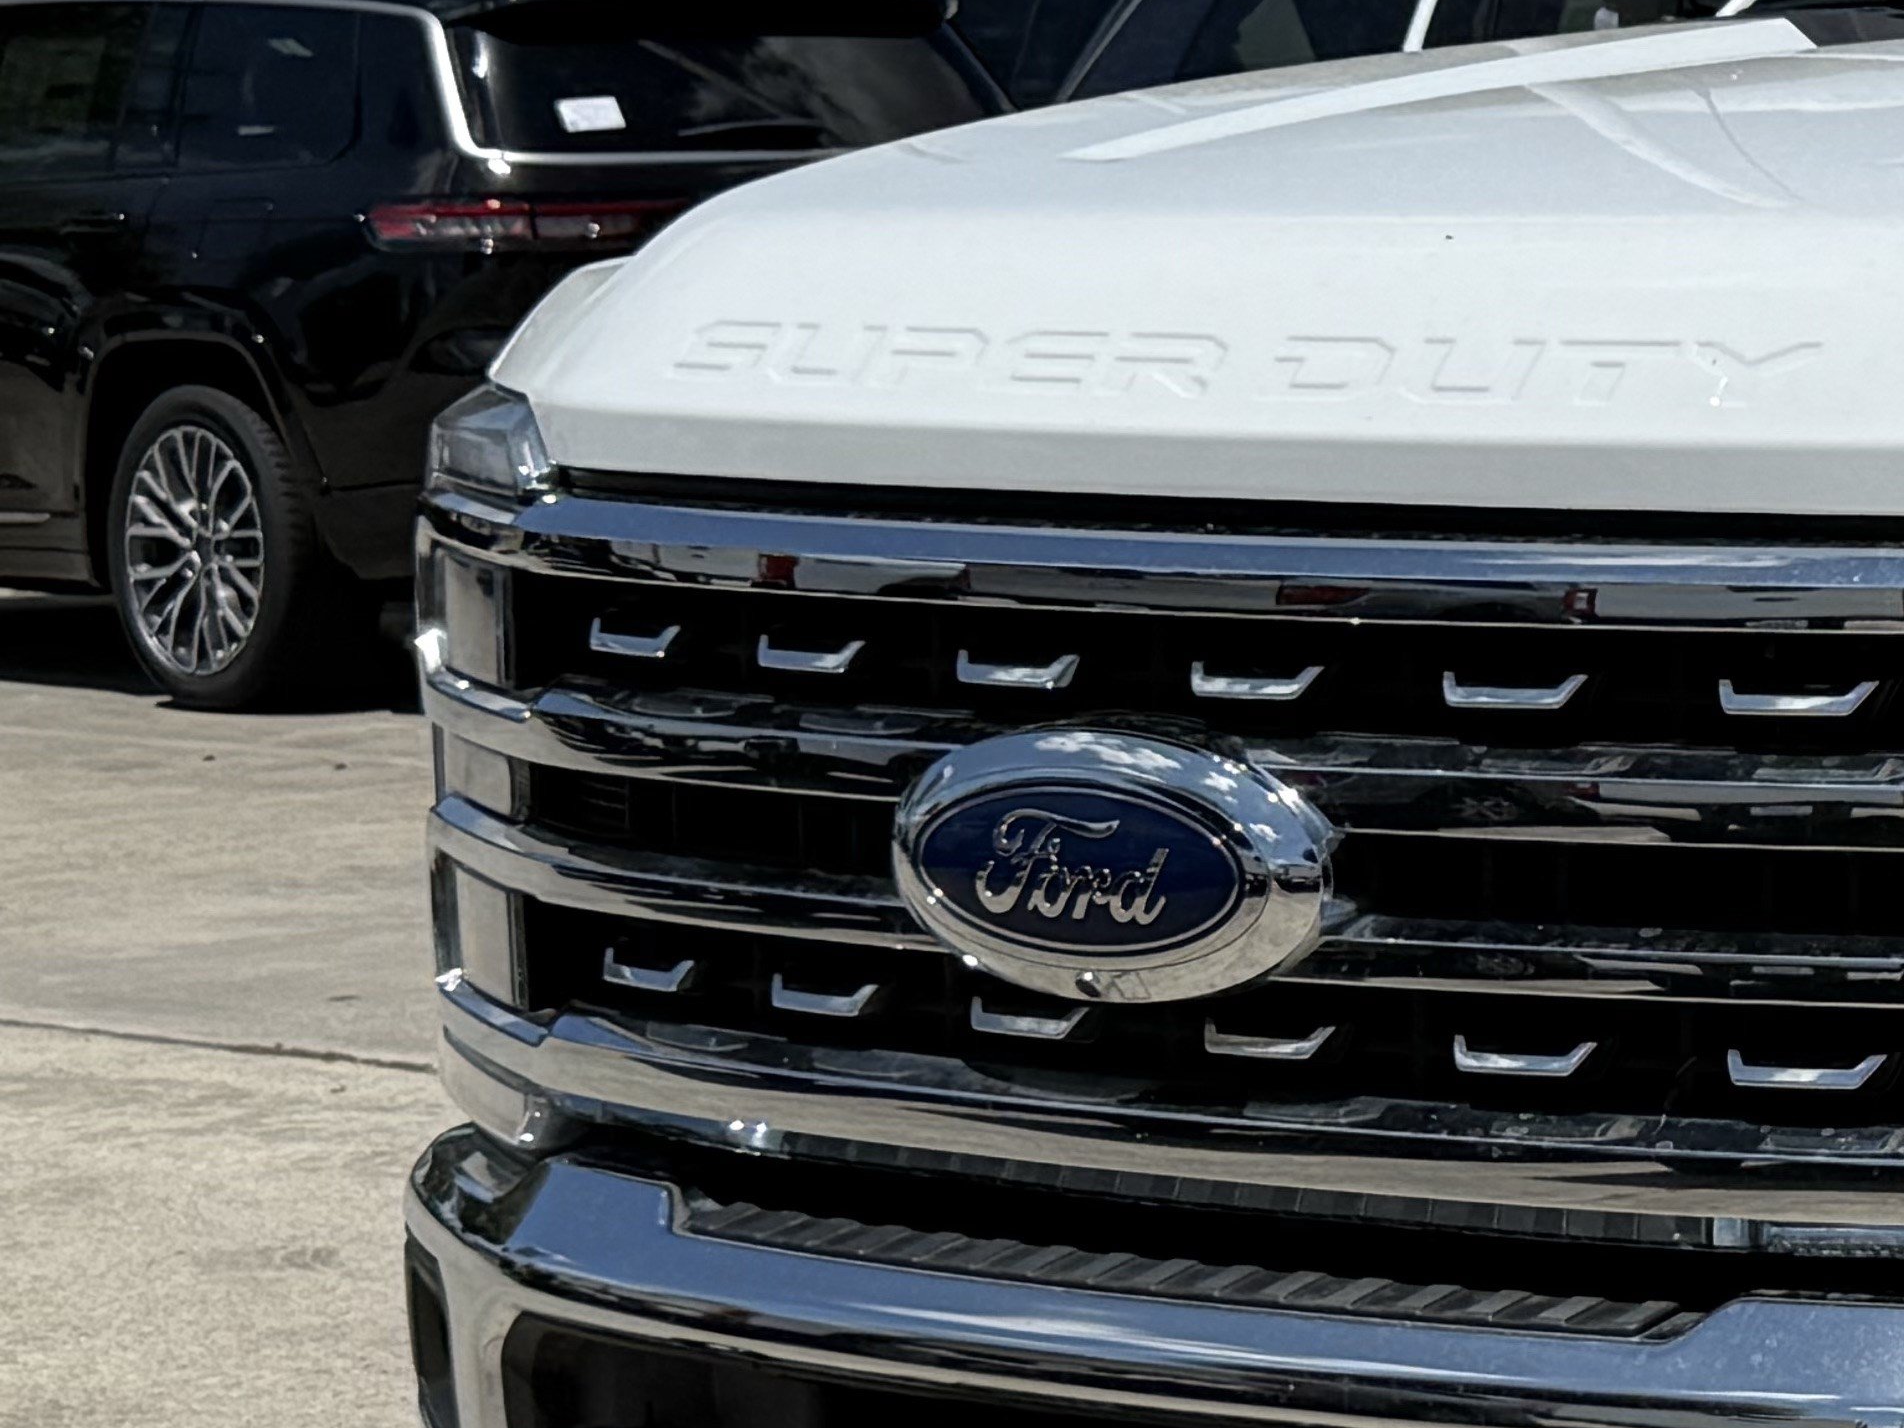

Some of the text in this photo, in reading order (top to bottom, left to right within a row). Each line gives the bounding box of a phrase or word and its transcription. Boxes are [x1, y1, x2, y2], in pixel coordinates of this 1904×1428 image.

[673, 320, 1824, 409] SUPER DUTY
[975, 807, 1170, 927] Ford
